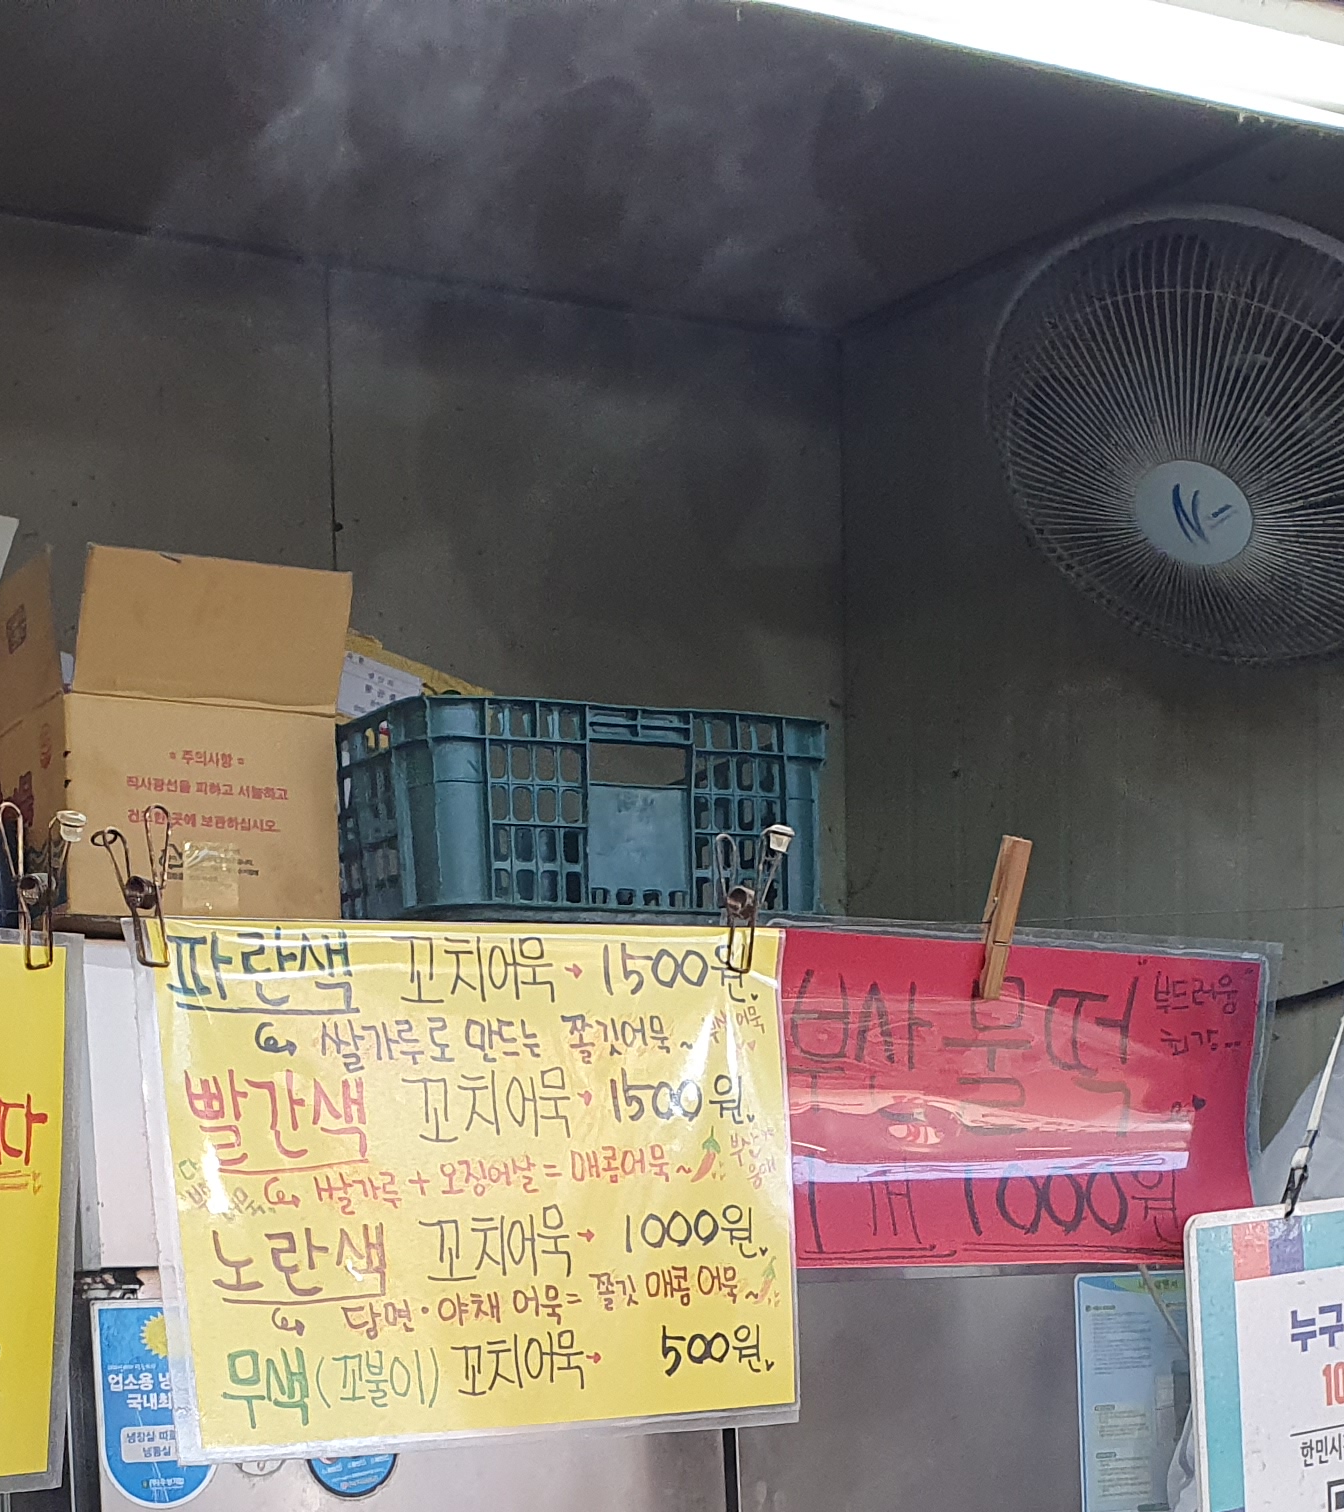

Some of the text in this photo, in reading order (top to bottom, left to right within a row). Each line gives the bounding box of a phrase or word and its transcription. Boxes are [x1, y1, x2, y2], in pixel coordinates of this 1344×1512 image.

[182, 750, 233, 768] 주의사항
[126, 776, 288, 800] 직사광선을 피하고 서늘하고
[172, 812, 196, 828] 곳에
[166, 927, 353, 1010] 파란색
[391, 936, 555, 1002] 꼬치어묵
[321, 1017, 456, 1073] 쌀가루로
[465, 1018, 541, 1062] 만드는
[184, 1069, 368, 1160] 빨간색
[401, 1067, 571, 1142] 꼬치어묵
[440, 1155, 539, 1197] 오징어살
[213, 1221, 386, 1299] 노란색
[419, 1204, 570, 1282] 꼬치어묵
[589, 1272, 639, 1311] 쫄깃
[645, 1265, 690, 1306] 매콤
[108, 1373, 154, 1392] 업소용
[222, 1346, 310, 1430] 무색
[454, 1330, 585, 1397] 꼬치어묵
[661, 1324, 762, 1377] 500원
